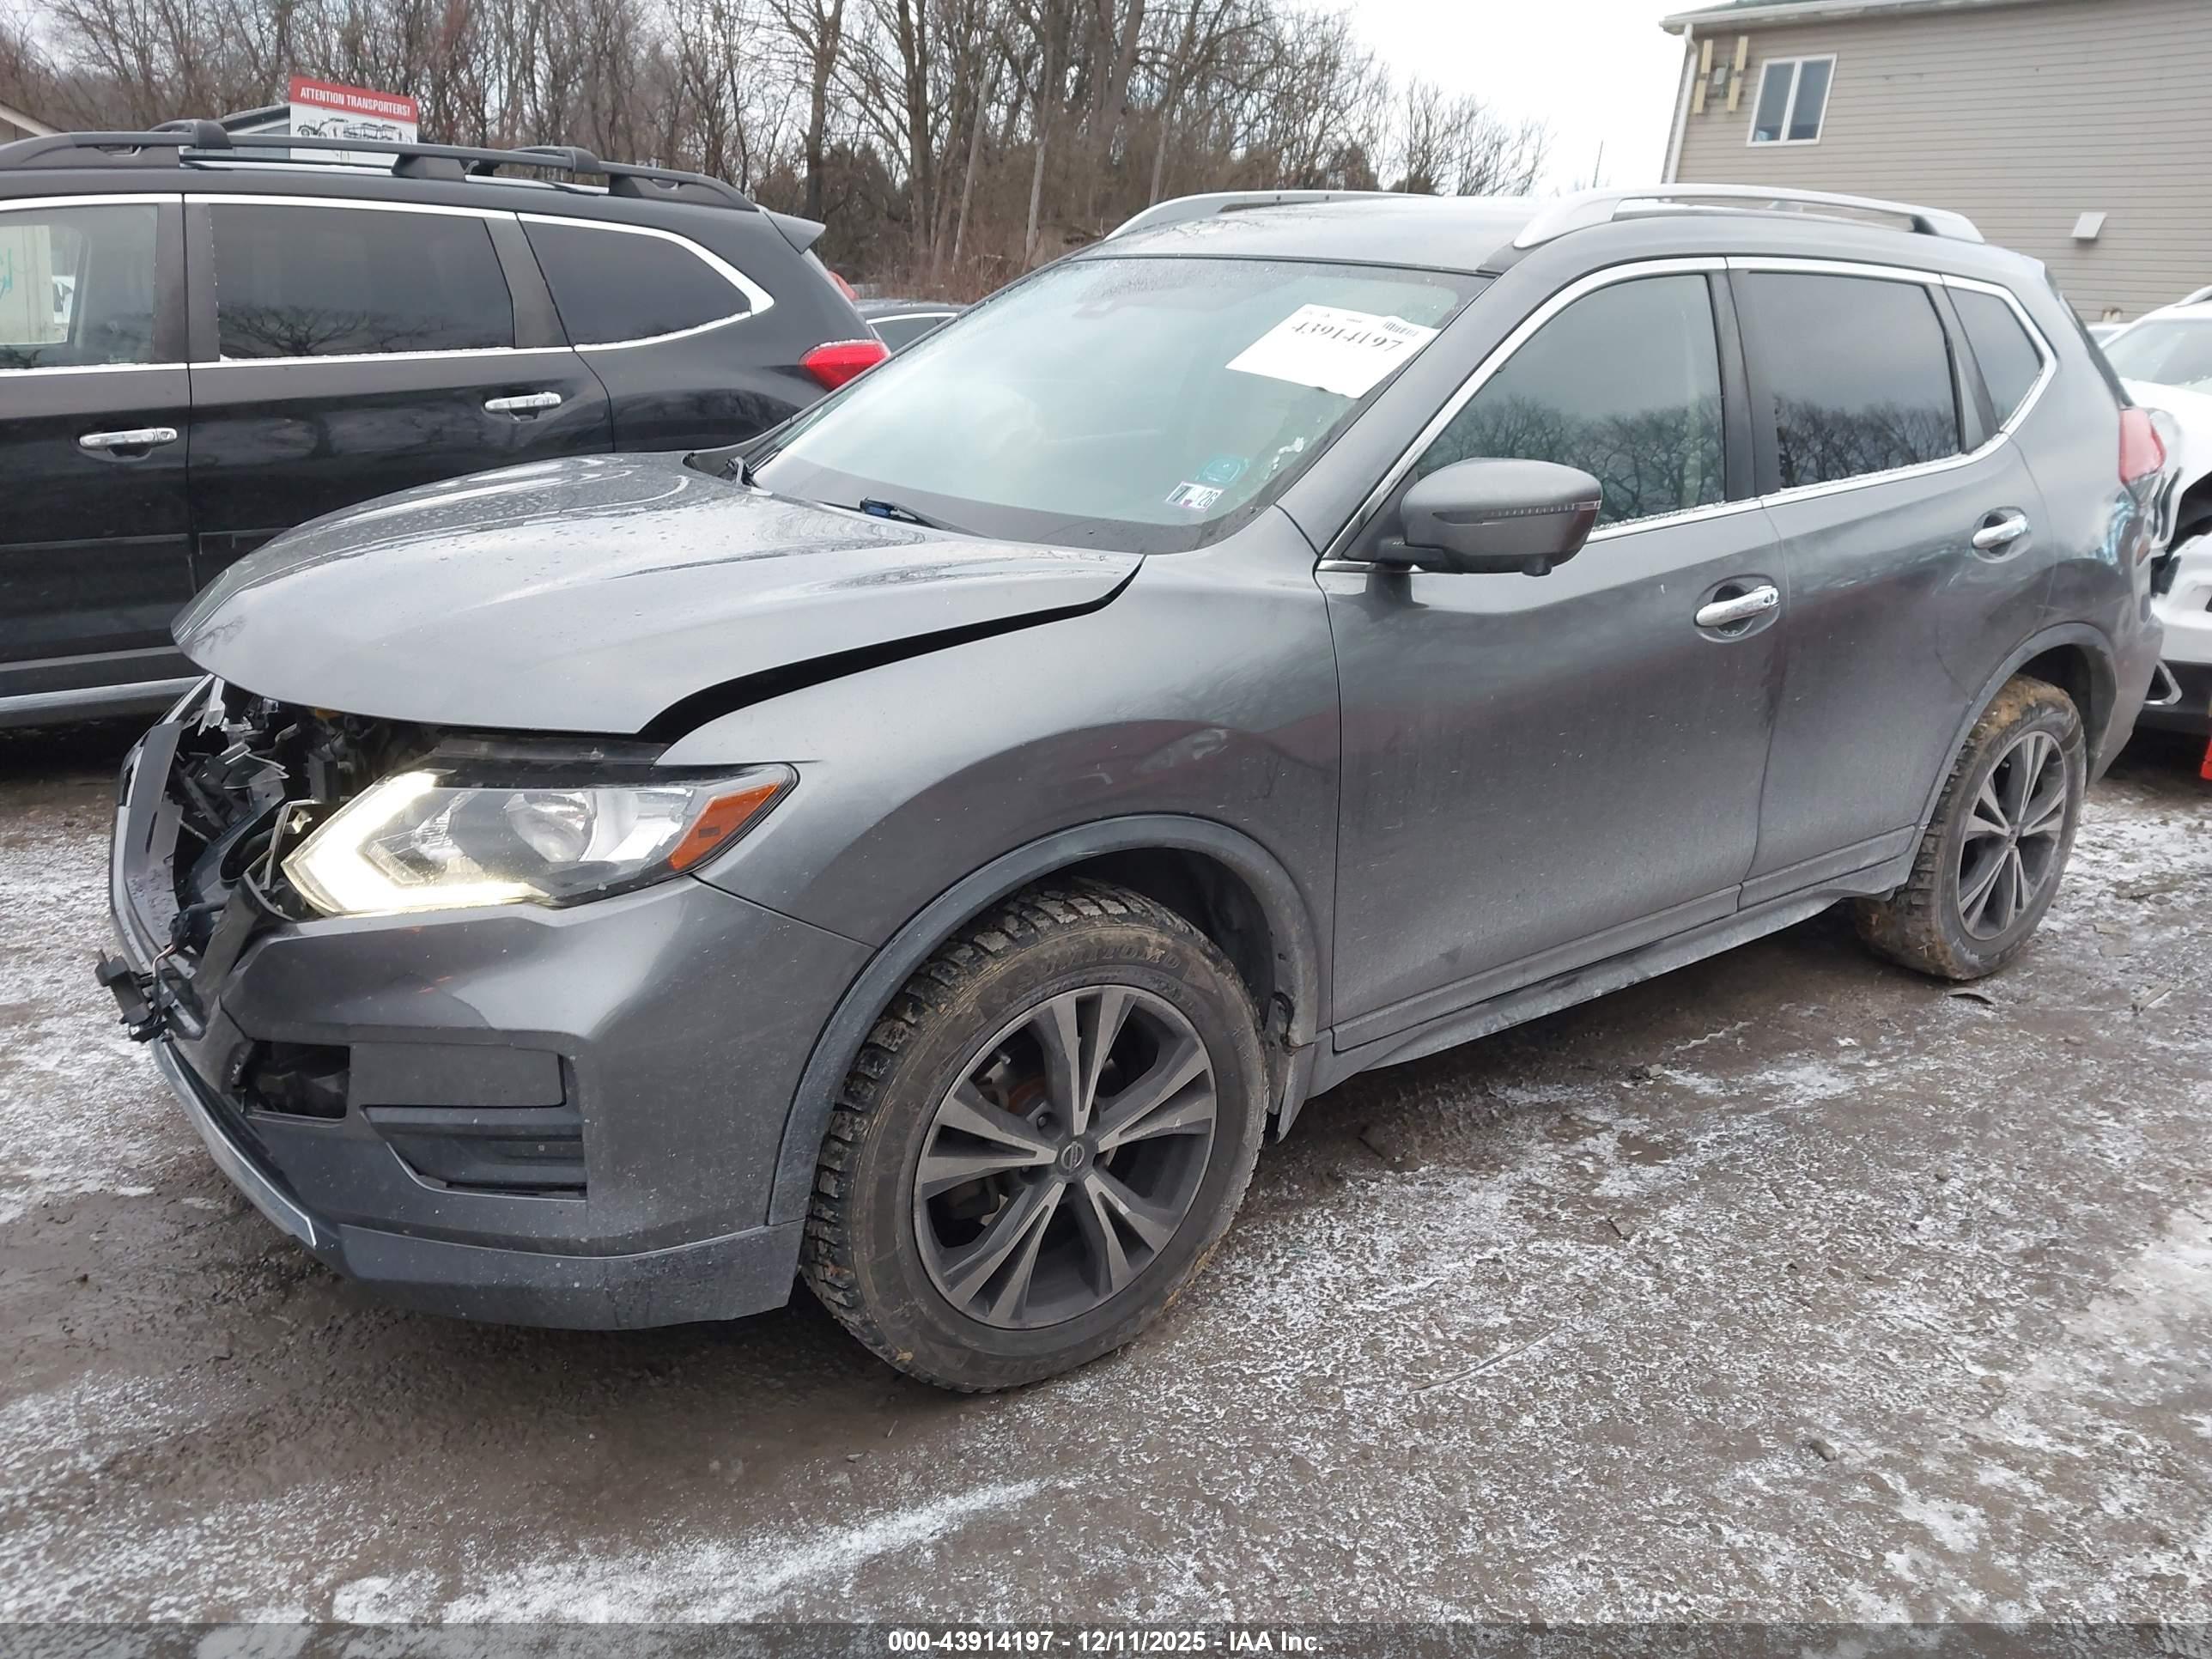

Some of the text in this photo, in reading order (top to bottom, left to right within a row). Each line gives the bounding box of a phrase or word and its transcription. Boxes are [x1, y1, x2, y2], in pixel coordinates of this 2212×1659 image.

[300, 87, 410, 116] ATTENTION TRANSPORTERS!
[1291, 320, 1405, 352] 43914197
